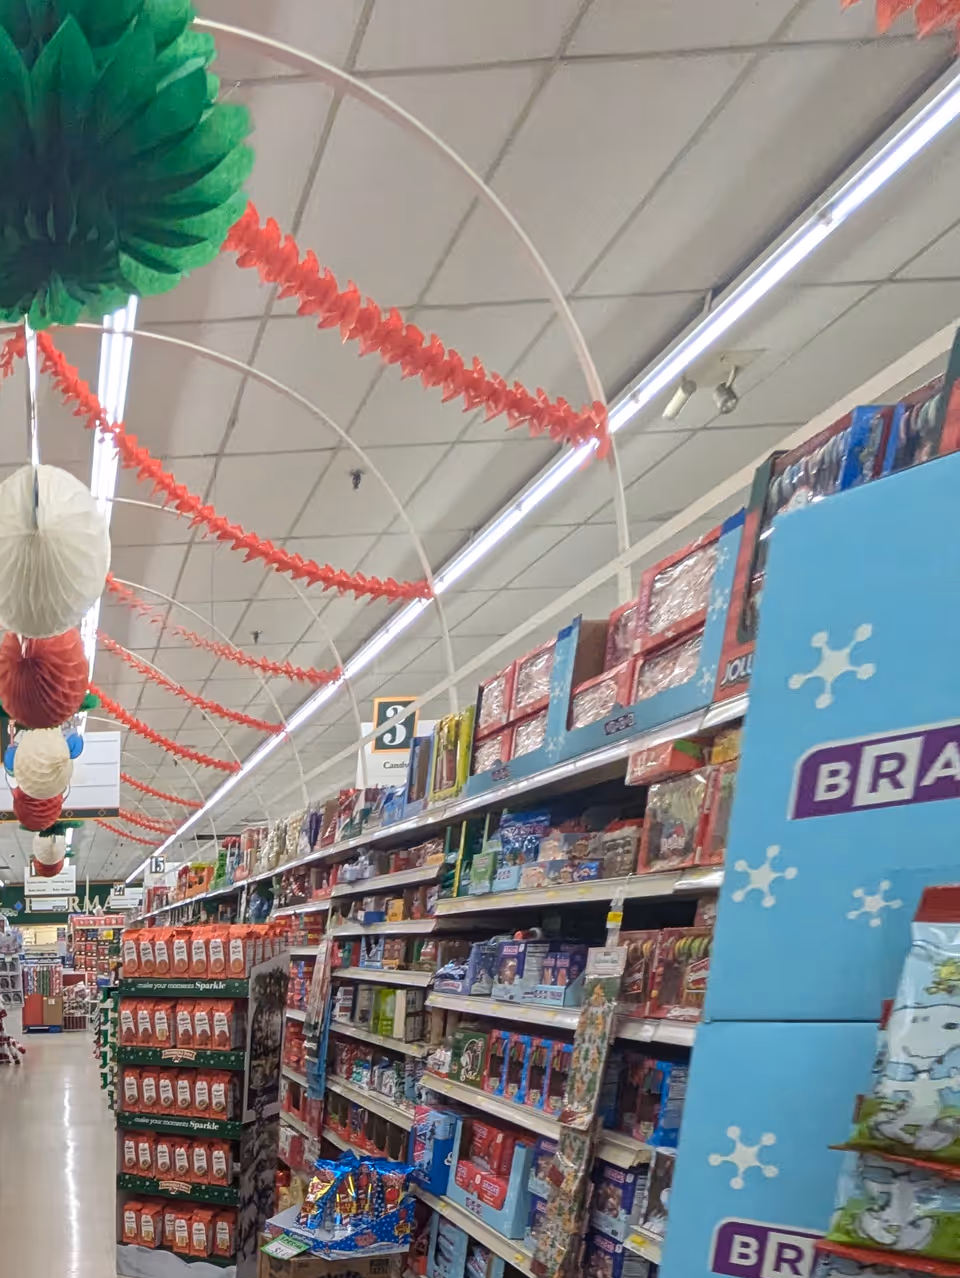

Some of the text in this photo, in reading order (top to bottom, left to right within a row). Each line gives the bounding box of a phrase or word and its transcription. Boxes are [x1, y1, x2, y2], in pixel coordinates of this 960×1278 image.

[720, 654, 753, 688] JOLL
[383, 705, 406, 745] 3
[813, 741, 960, 802] BRA
[151, 857, 164, 873] 15
[154, 983, 167, 991] your
[195, 981, 226, 991] Sparkle
[149, 1118, 163, 1126] your
[189, 1120, 220, 1131] Sparkle
[279, 1235, 304, 1250] SPECIAL
[728, 1235, 804, 1277] BR
